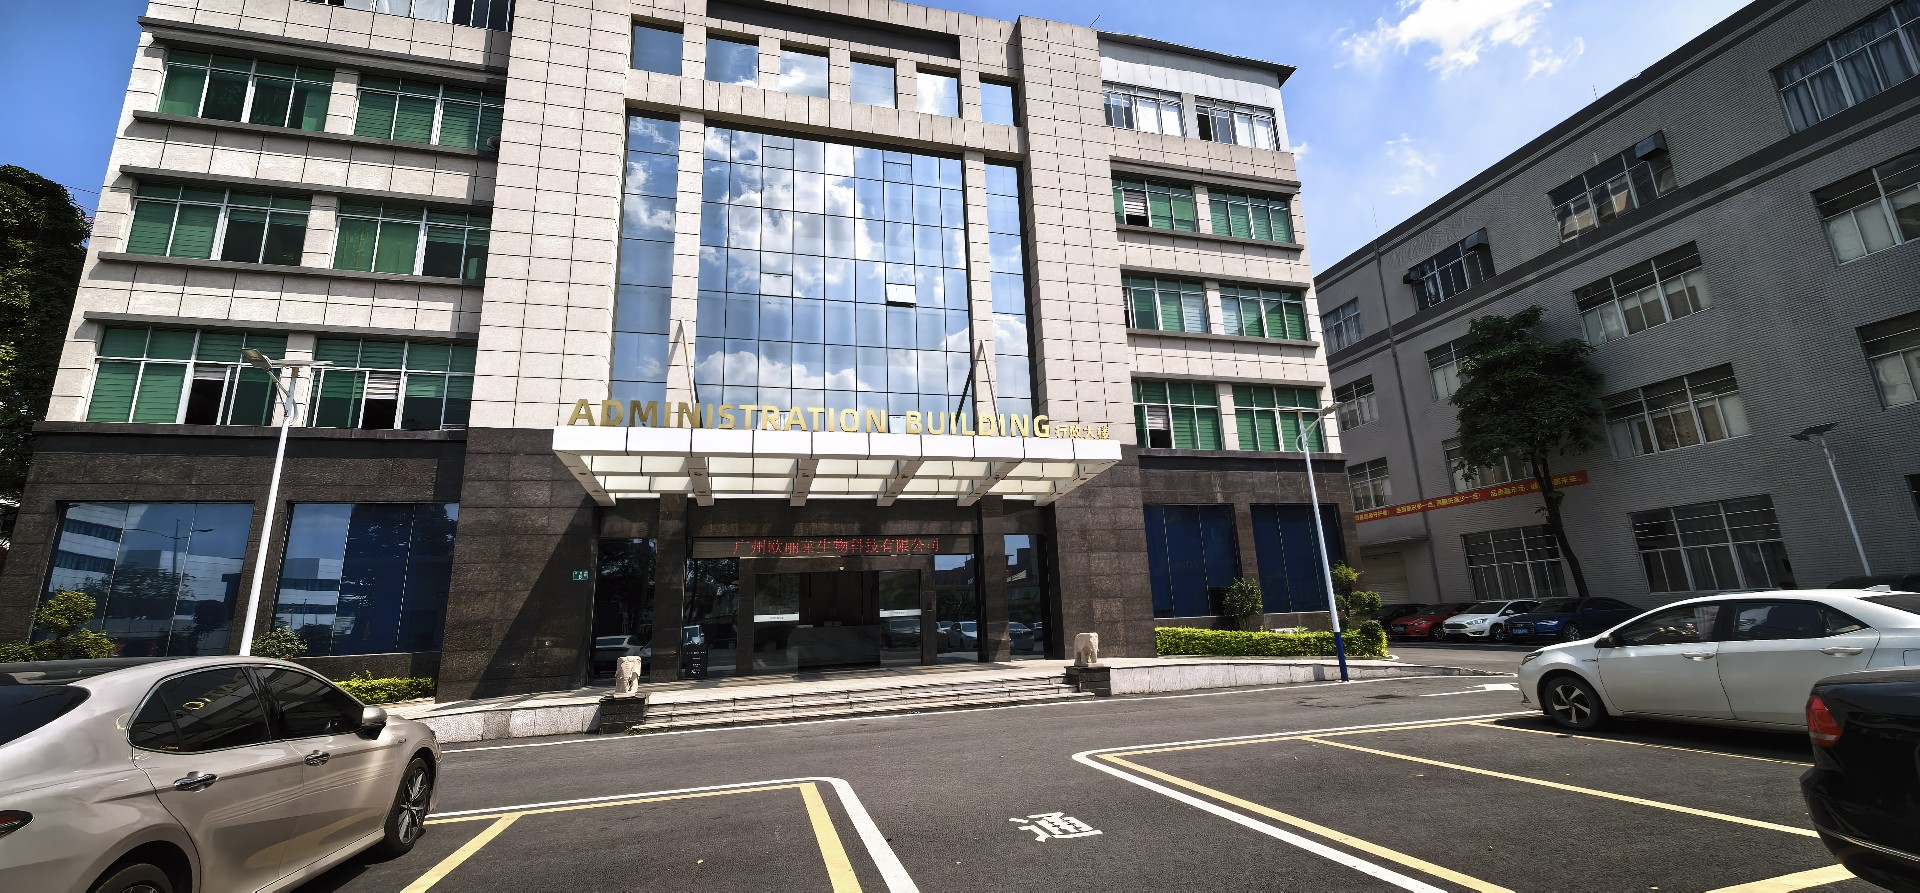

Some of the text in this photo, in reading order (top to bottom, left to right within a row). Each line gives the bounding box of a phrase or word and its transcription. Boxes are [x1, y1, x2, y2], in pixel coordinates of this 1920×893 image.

[567, 399, 1050, 438] ADMINISTRATION BUILDING
[1055, 424, 1110, 440] 行政大楼
[1009, 812, 1103, 842] 通
